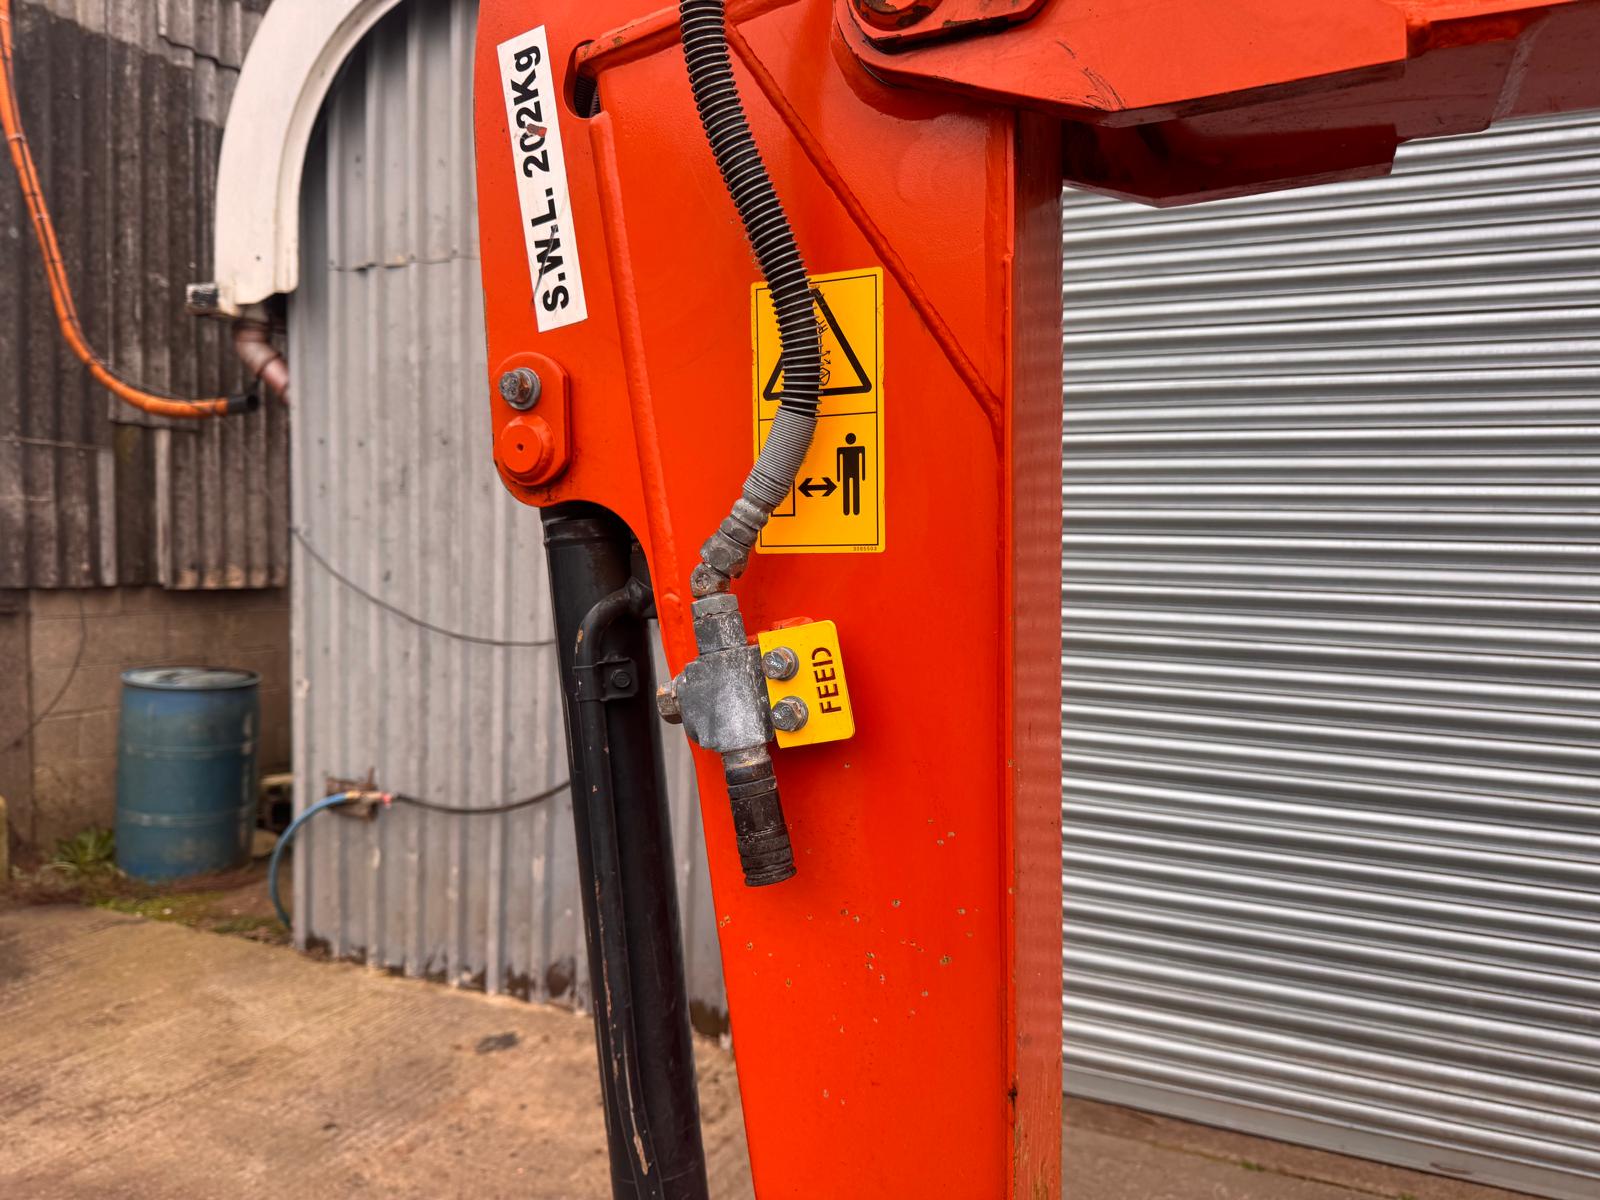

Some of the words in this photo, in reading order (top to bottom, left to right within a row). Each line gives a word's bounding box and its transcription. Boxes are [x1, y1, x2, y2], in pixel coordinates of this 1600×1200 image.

[511, 46, 550, 178] 202Kg
[532, 187, 569, 312] S.W.L.
[811, 647, 842, 714] FEED
